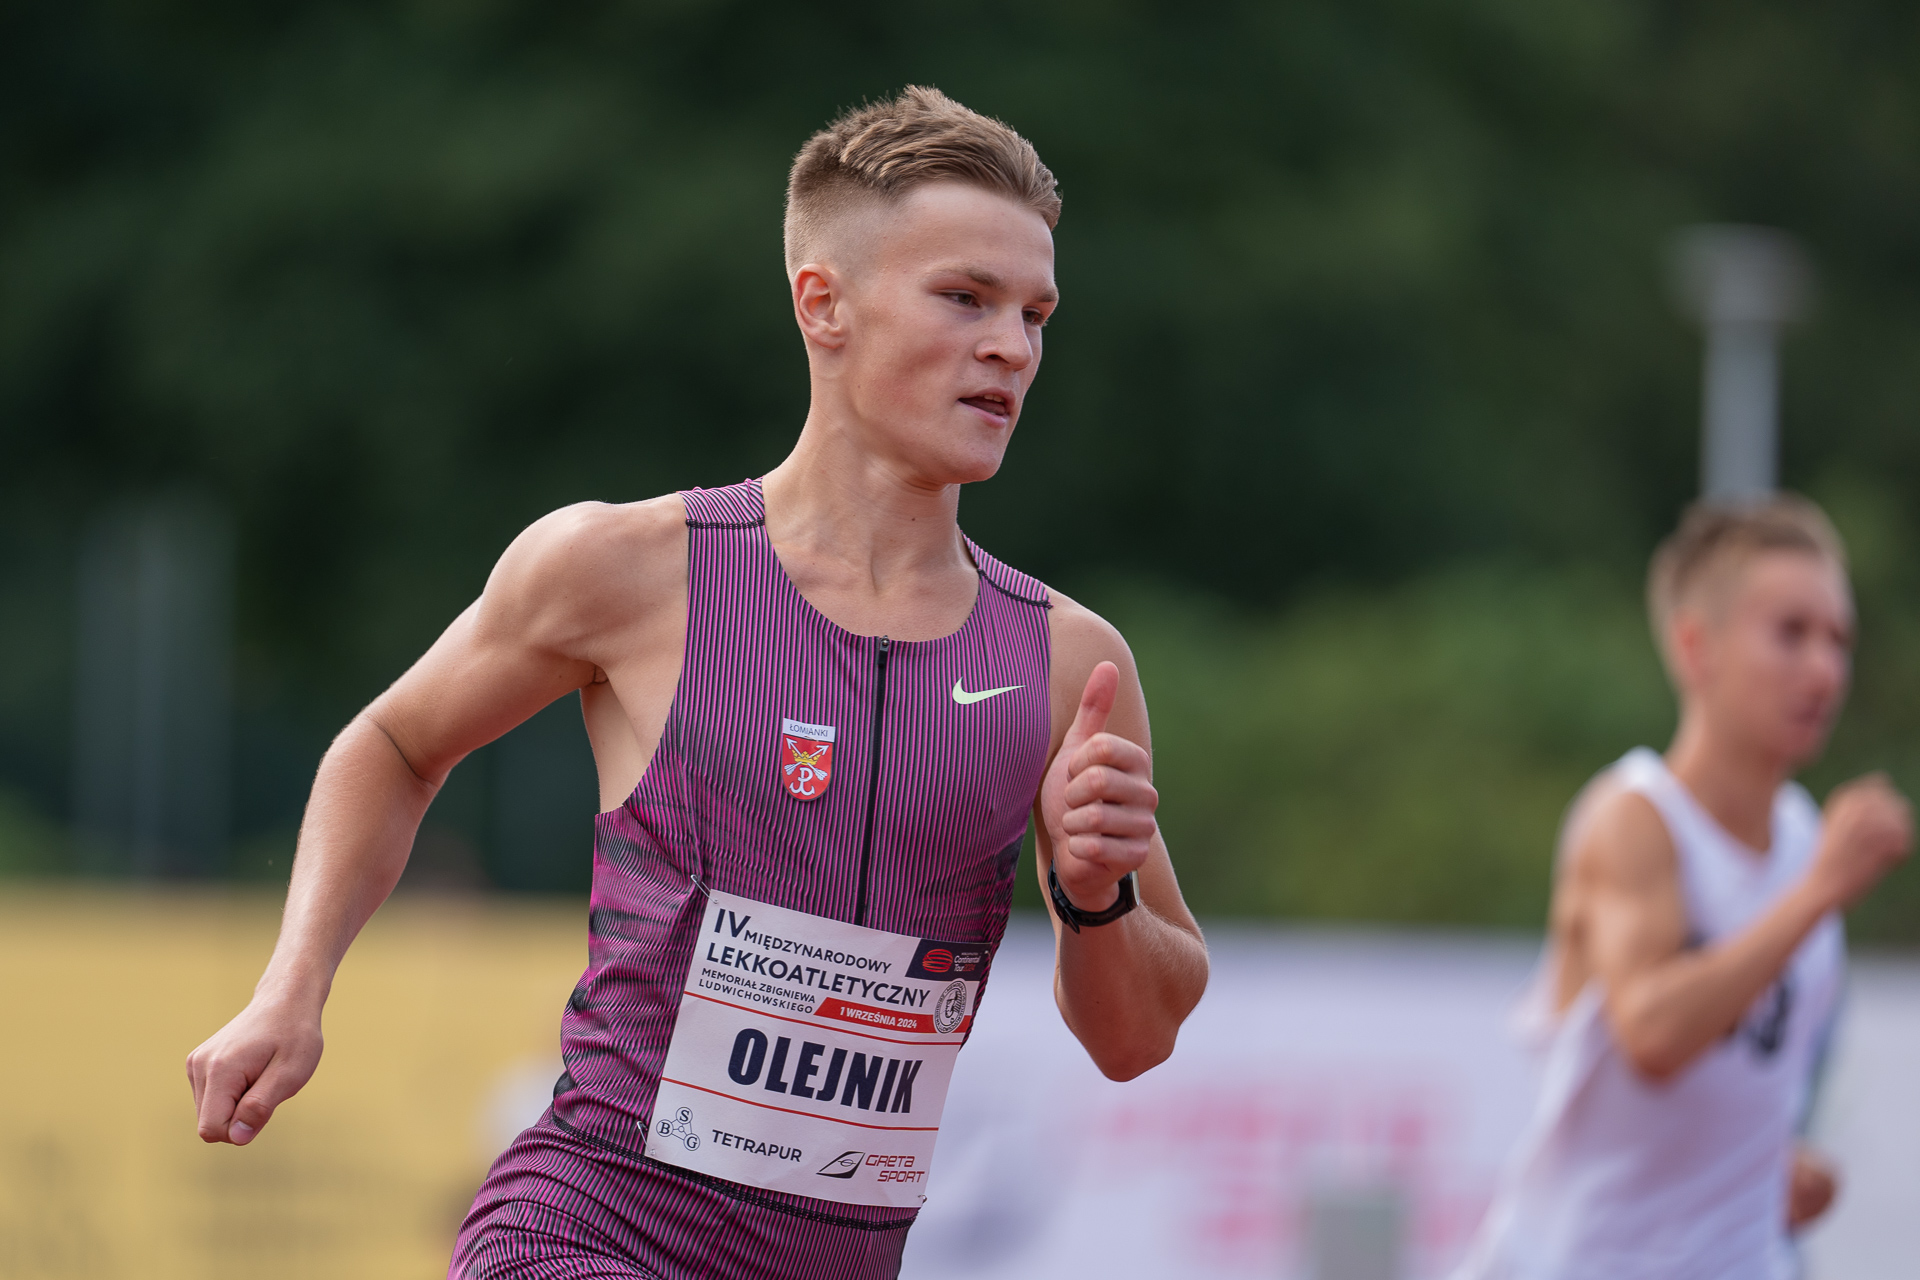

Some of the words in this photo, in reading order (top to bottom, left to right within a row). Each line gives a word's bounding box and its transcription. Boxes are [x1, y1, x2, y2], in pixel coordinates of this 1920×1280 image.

[789, 723, 828, 737] ŁOMIANKI
[714, 908, 751, 938] IV
[743, 930, 892, 974] MIĘDZYNARODOWY
[954, 955, 982, 964] Continental
[954, 964, 964, 972] Tour
[706, 942, 931, 1007] LEKKOATLETYCZNY
[701, 967, 758, 990] MEMORIAŁ
[758, 982, 816, 1004] ZBIGNIEWA
[698, 978, 813, 1014] LUDWICHOWSKIEGO
[839, 1006, 845, 1016] 1
[847, 1007, 896, 1026] WRZEŚNIA
[897, 1018, 918, 1029] 2024
[727, 1028, 923, 1114] OLEJNIK
[679, 1109, 690, 1123] S
[659, 1122, 671, 1135] B
[686, 1136, 698, 1149] G
[712, 1129, 803, 1162] TETRAPUR
[877, 1170, 925, 1183] SPORT
